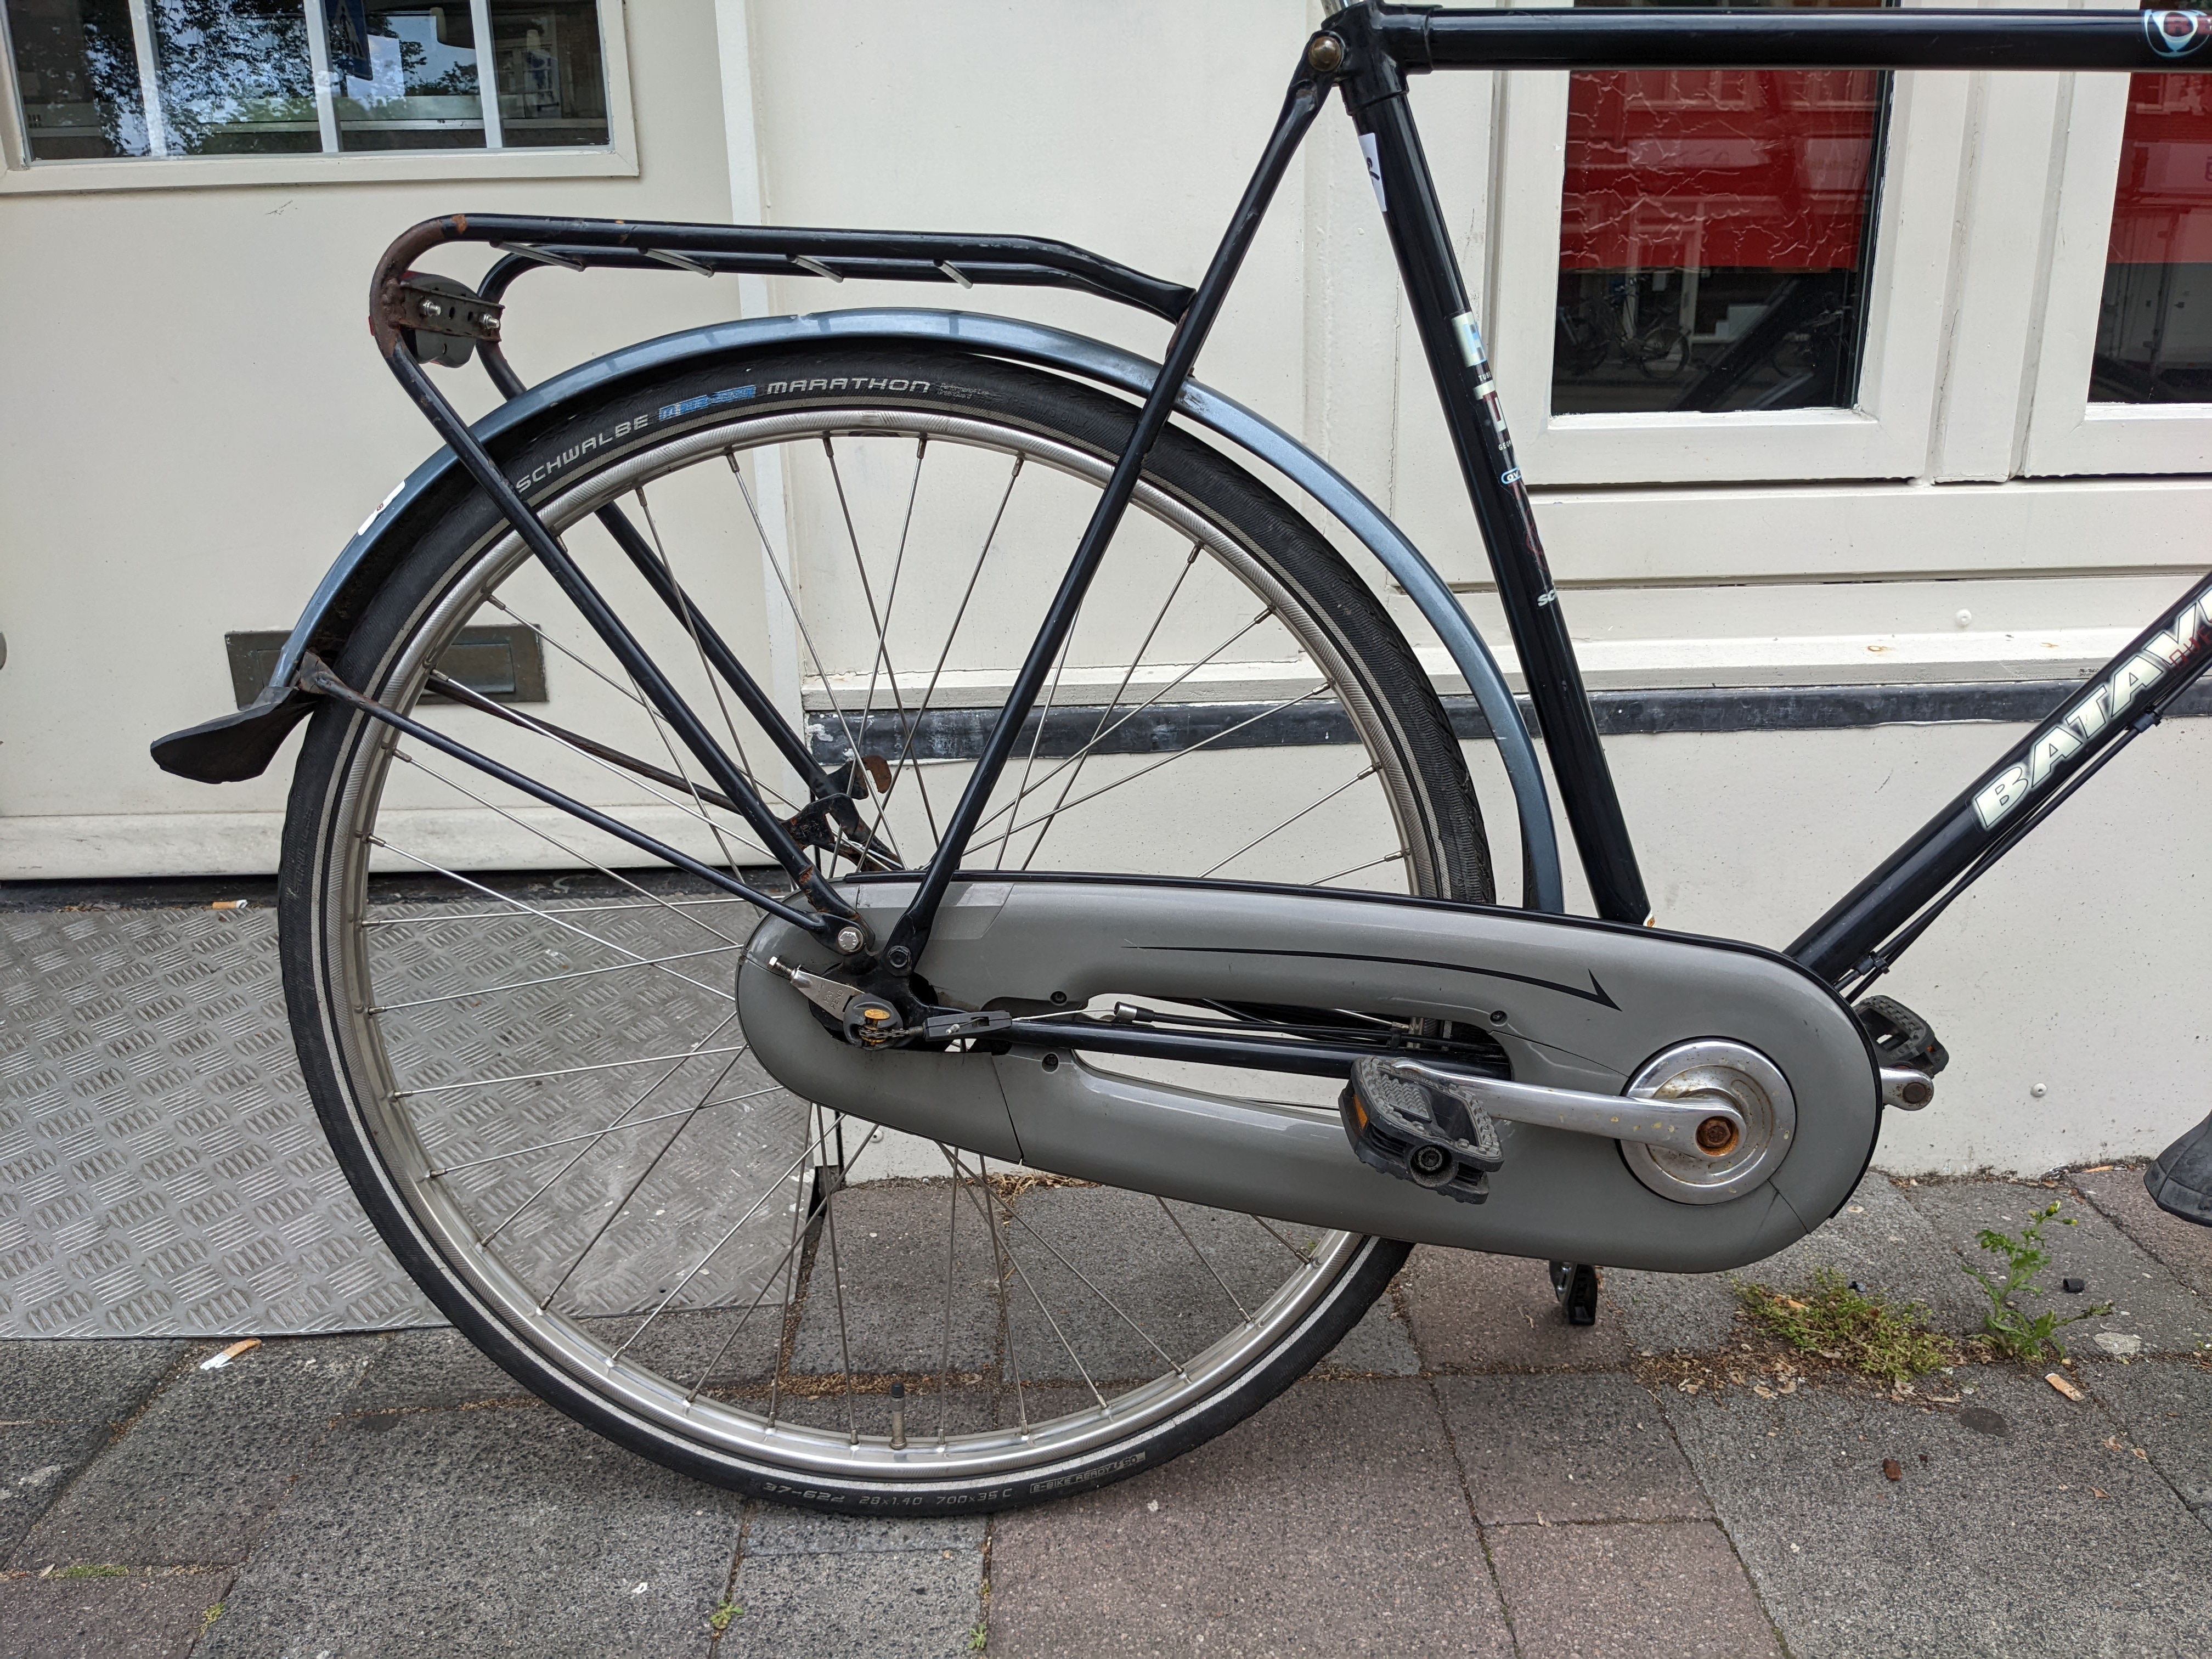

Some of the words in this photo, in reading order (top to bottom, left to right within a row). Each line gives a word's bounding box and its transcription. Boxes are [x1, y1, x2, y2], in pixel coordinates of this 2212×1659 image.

[766, 377, 930, 394] MARATHON
[516, 414, 648, 493] SCHWALBE
[830, 989, 844, 1009] PEND
[1033, 1477, 1071, 1492] E-BIKE
[1076, 1465, 1110, 1482] READY
[763, 1482, 845, 1503] 37-622
[859, 1496, 923, 1505] 28x1.40
